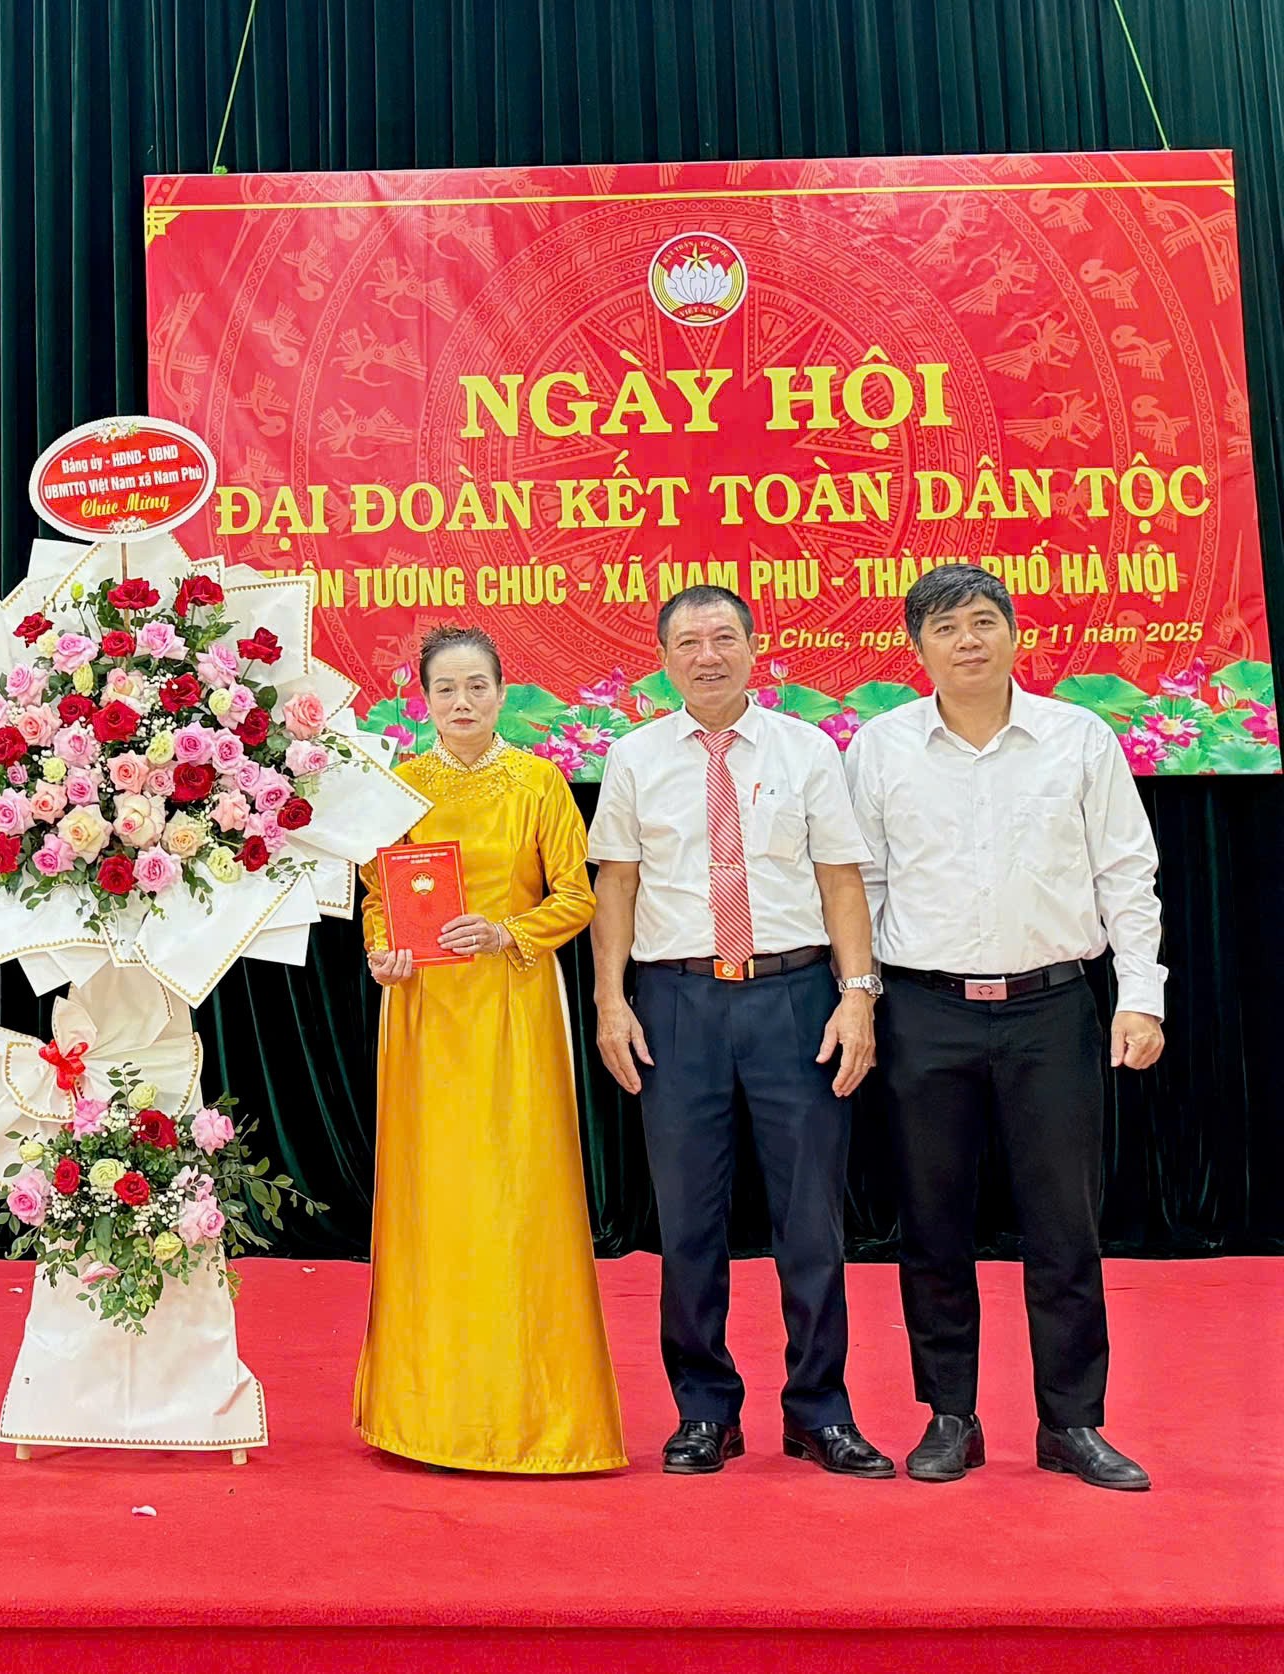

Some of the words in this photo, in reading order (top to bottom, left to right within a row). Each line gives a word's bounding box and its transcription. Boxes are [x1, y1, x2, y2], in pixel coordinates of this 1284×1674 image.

[459, 350, 733, 439] NGÀY
[763, 344, 953, 450] HỘI
[61, 458, 89, 474] Đảng
[90, 454, 103, 471] ủy
[148, 445, 179, 462] UBND
[44, 480, 87, 499] UBMTTQ
[89, 476, 110, 495] Việt
[111, 475, 136, 491] Nam
[138, 472, 152, 487] xã
[154, 469, 180, 485] Nam
[81, 497, 118, 518] Chúc
[122, 491, 171, 513] Mừng
[216, 483, 330, 551] ĐẠI
[350, 464, 535, 535] ĐOÀN
[557, 449, 688, 529] KẾT
[709, 456, 893, 527] TOÀN
[915, 455, 1054, 521] DÂN
[1075, 452, 1211, 535] TỘC
[354, 563, 466, 608] TƯƠNG
[476, 556, 567, 606] CHÚC
[603, 554, 649, 604] XÃ
[750, 550, 821, 601] PHÙ
[854, 548, 968, 598] THÀ
[1060, 544, 1110, 595] HÀ
[1118, 543, 1180, 603] NỘI
[779, 627, 851, 651] Chúc,
[1048, 623, 1073, 644] 11
[1083, 622, 1137, 643] năm
[1146, 622, 1203, 643] 2025
